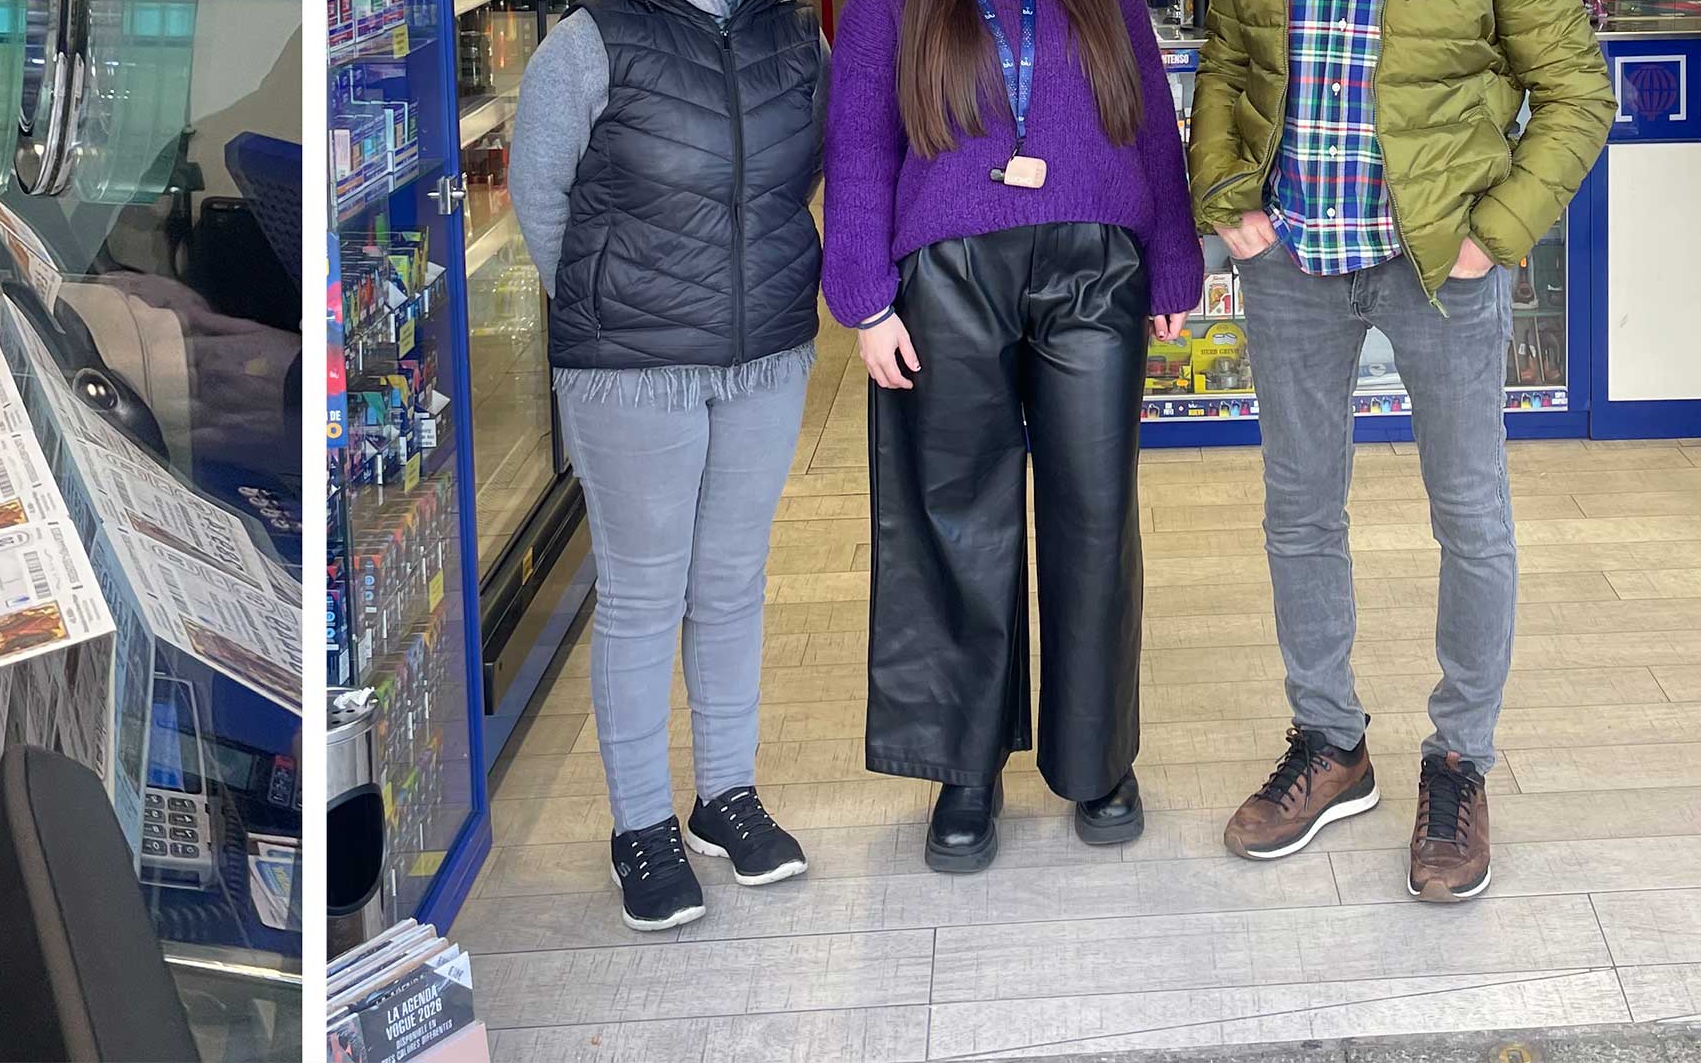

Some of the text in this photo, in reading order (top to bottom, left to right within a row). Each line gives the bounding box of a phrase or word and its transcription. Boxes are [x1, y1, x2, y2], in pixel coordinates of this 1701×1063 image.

[329, 410, 341, 422] DE
[386, 997, 443, 1041] VOGUE 2026
[387, 984, 438, 1024] LA AGENDA
